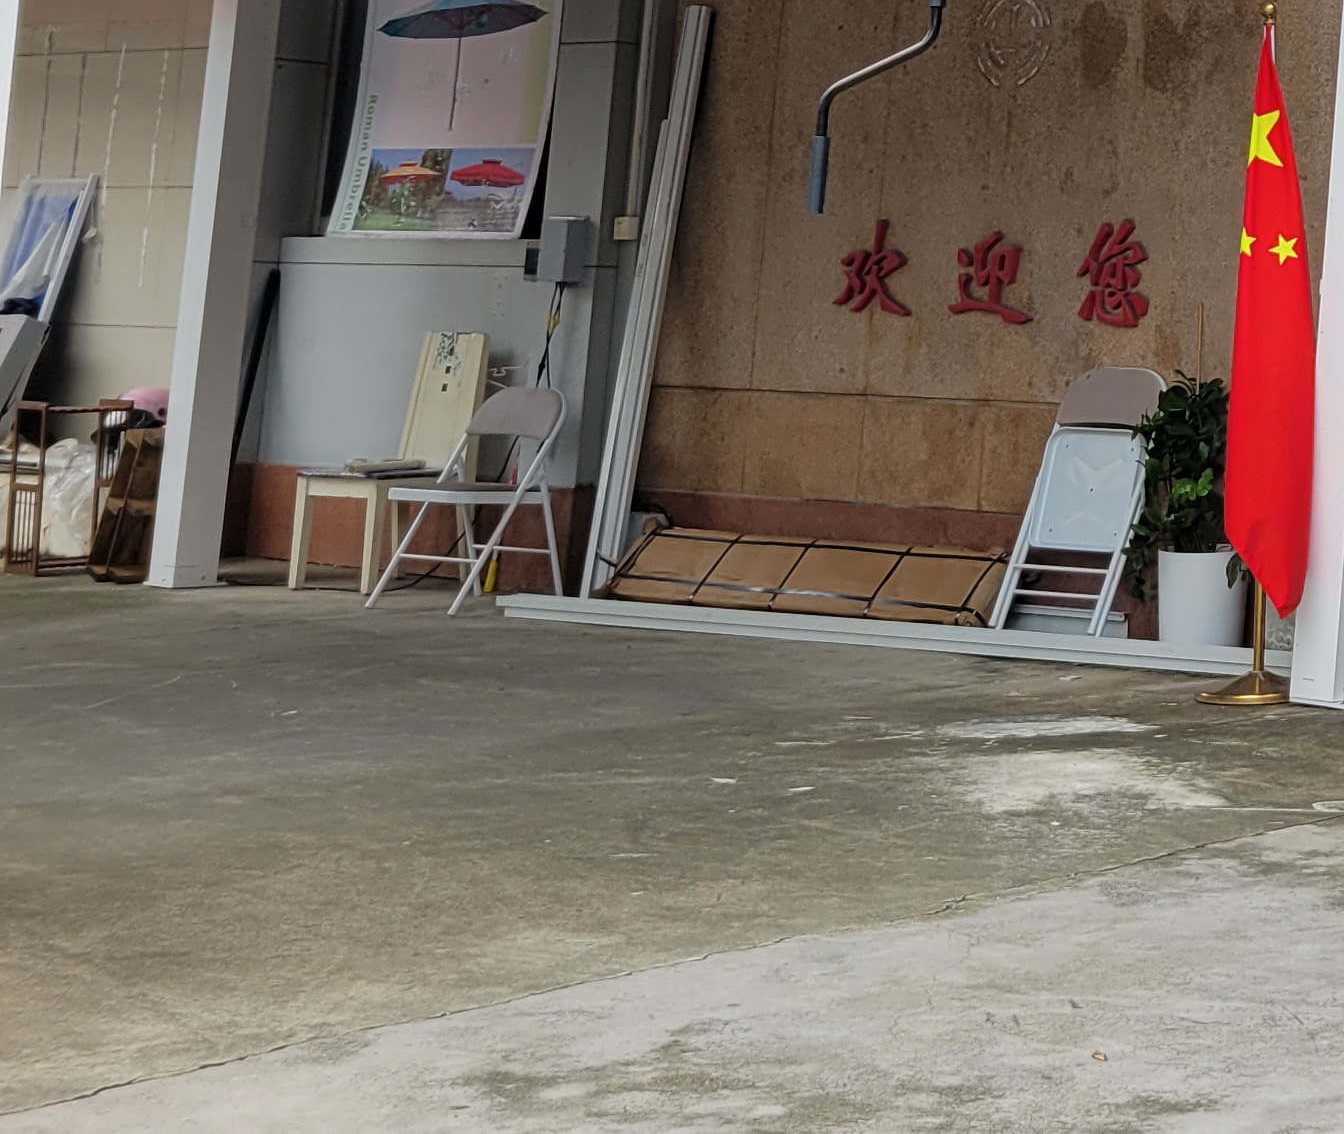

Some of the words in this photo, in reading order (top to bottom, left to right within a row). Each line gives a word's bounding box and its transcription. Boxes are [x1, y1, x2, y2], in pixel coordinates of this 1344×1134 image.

[361, 95, 378, 151] Roman
[339, 156, 368, 230] Umbrella
[832, 219, 1149, 327] 欢迎您
